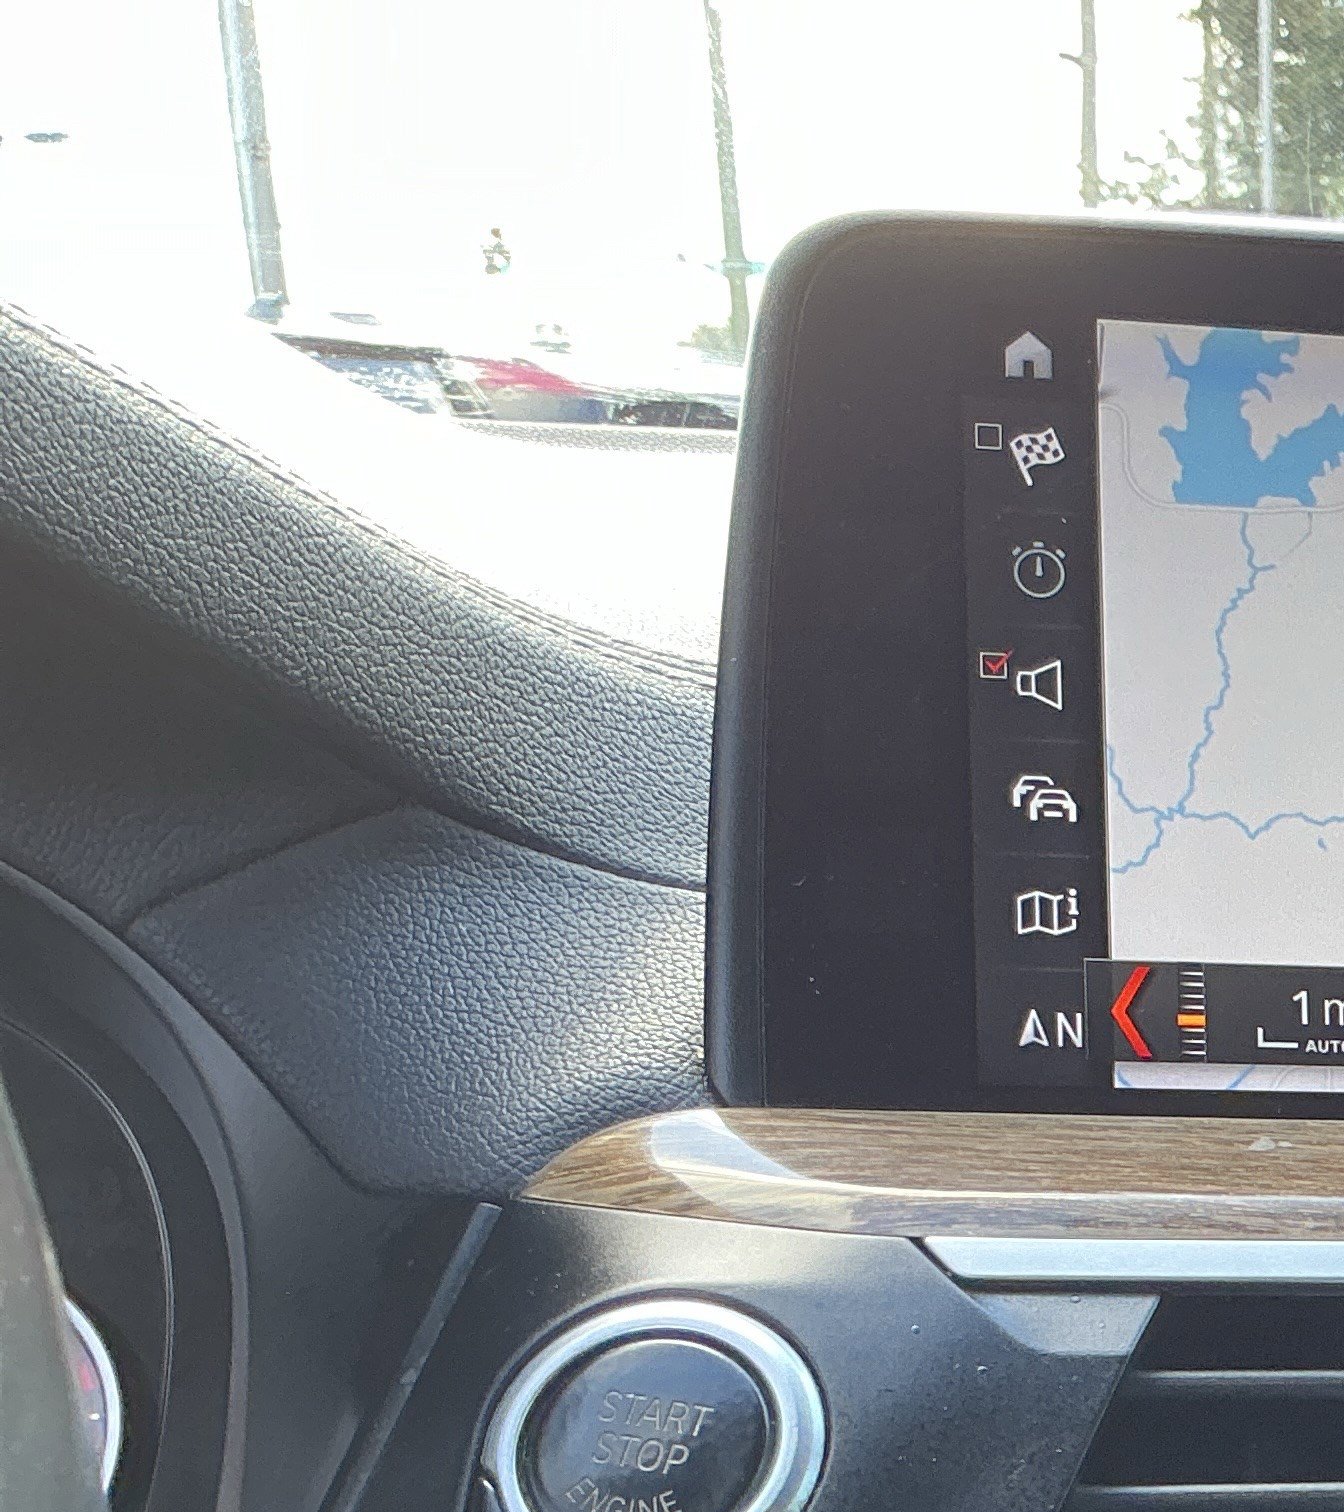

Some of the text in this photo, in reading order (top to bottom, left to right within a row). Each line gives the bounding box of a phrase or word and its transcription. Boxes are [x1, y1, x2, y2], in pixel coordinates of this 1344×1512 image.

[1292, 991, 1309, 1025] 1
[1057, 1012, 1083, 1047] N
[598, 1390, 715, 1437] START
[592, 1432, 689, 1475] STOP
